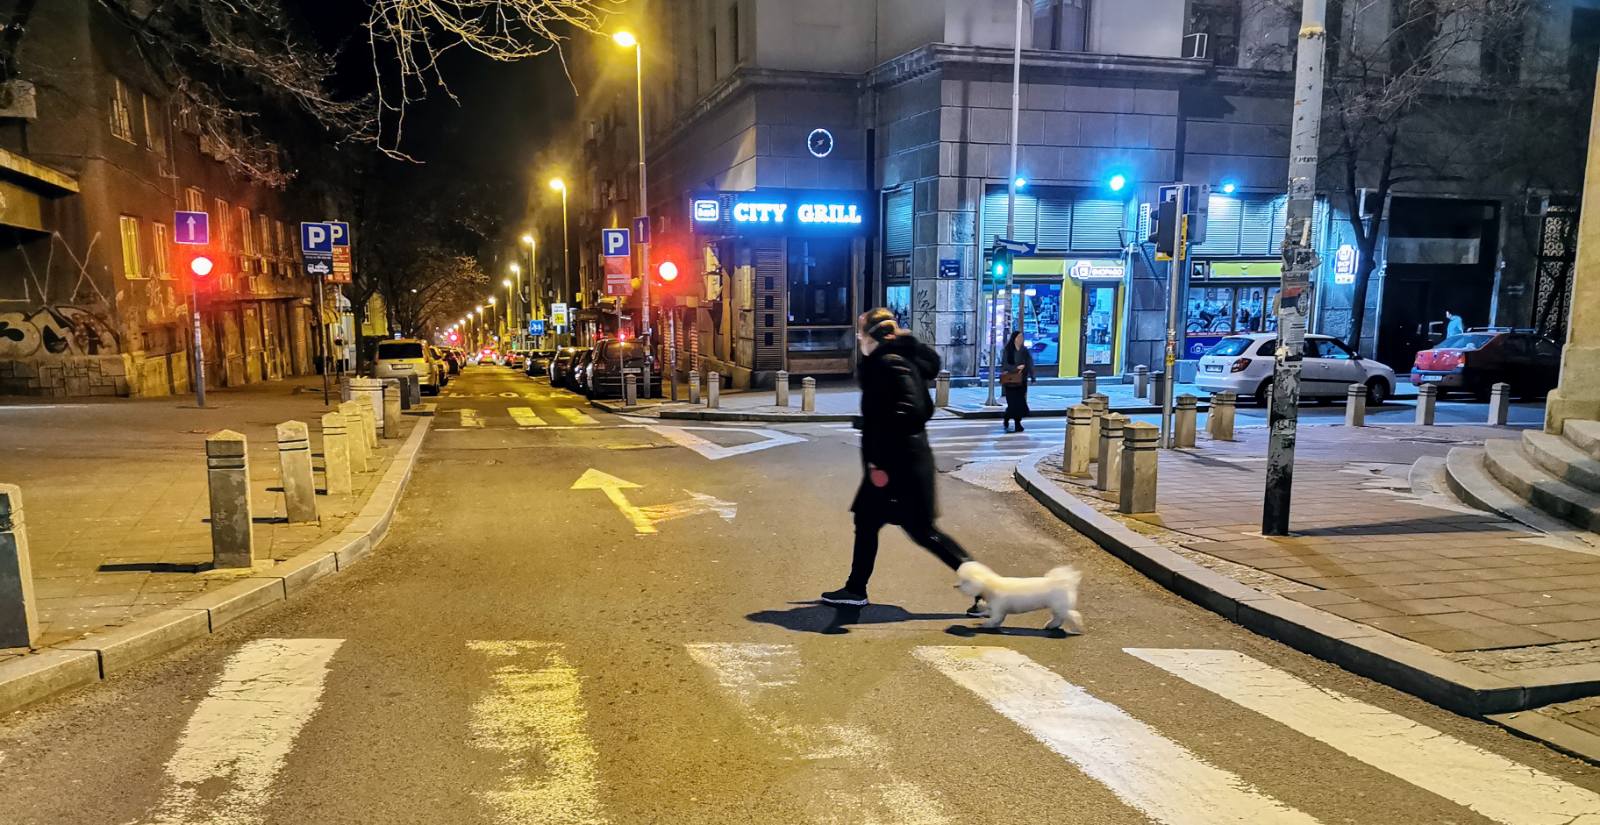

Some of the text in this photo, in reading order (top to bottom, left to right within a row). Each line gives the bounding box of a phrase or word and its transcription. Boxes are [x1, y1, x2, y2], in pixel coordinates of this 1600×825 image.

[734, 203, 787, 222] CITY
[798, 204, 861, 223] GRILL
[308, 226, 325, 249] P
[331, 224, 343, 243] P
[608, 232, 624, 254] P
